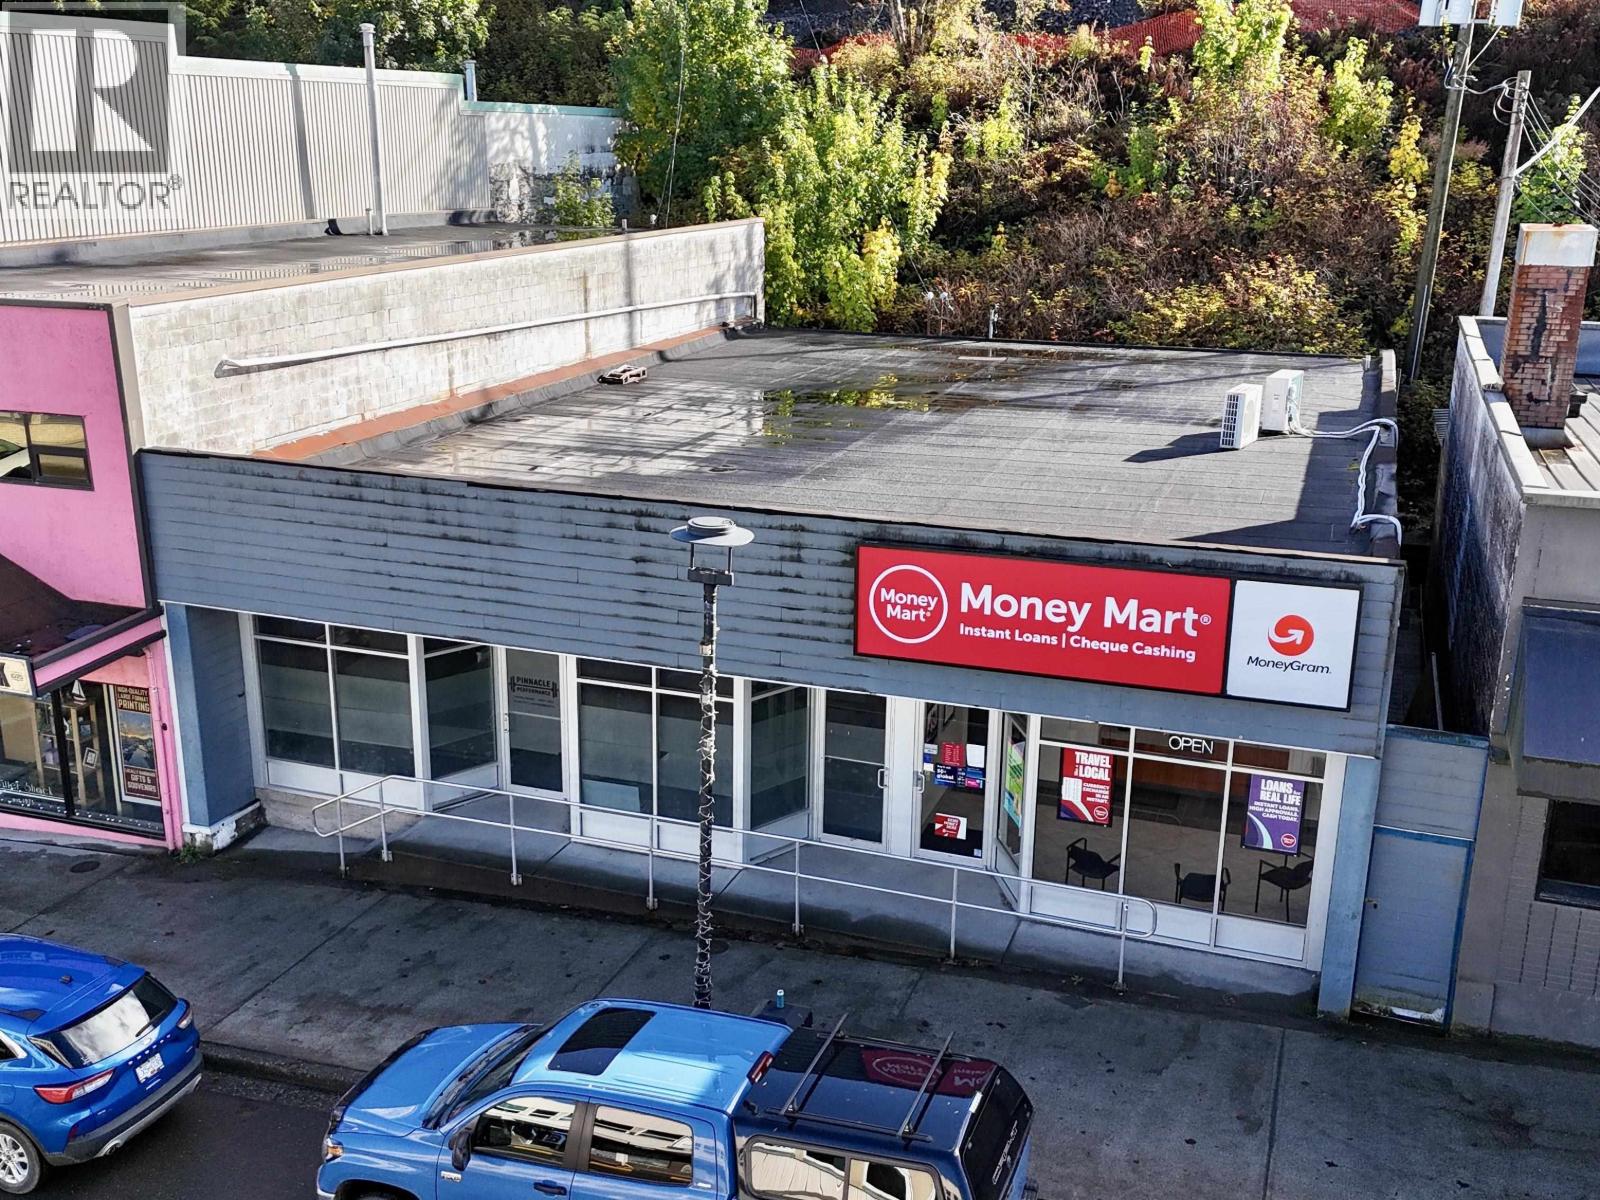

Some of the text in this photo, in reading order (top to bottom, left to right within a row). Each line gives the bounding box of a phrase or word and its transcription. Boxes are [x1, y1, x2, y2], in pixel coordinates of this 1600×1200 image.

[881, 588, 938, 611] Money
[960, 582, 1091, 633] Money
[959, 623, 1196, 662] Instant Loans Cheque Cashing
[516, 676, 551, 688] PINNACLE
[516, 687, 551, 696] PERFORMANCE
[118, 699, 150, 712] PRINTING
[1168, 735, 1214, 754] OPEN
[1075, 751, 1112, 768] TRAVEL
[1079, 765, 1111, 781] LOCAL
[1261, 779, 1294, 794] LOANS
[1254, 801, 1278, 809] INSTANT
[1260, 790, 1302, 805] REAL LIFE
